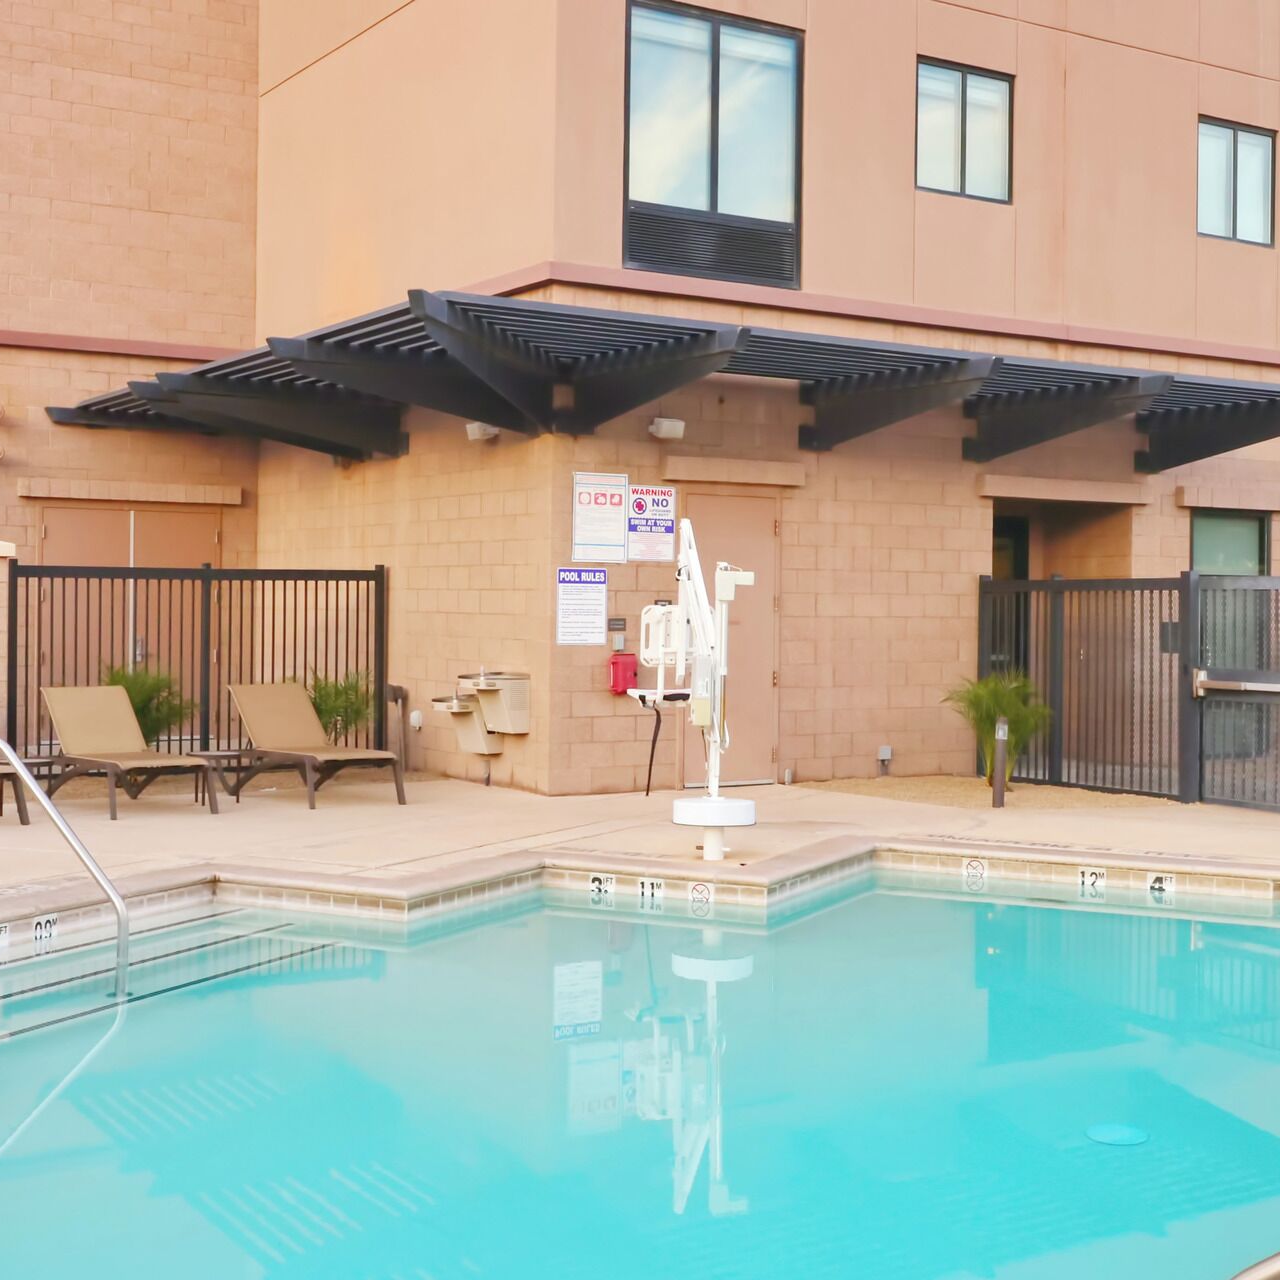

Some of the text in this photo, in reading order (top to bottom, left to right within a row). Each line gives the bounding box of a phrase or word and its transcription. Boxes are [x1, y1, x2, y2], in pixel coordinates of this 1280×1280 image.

[631, 488, 673, 497] WARNING
[651, 498, 669, 508] NO
[559, 571, 605, 582] POOL RULES
